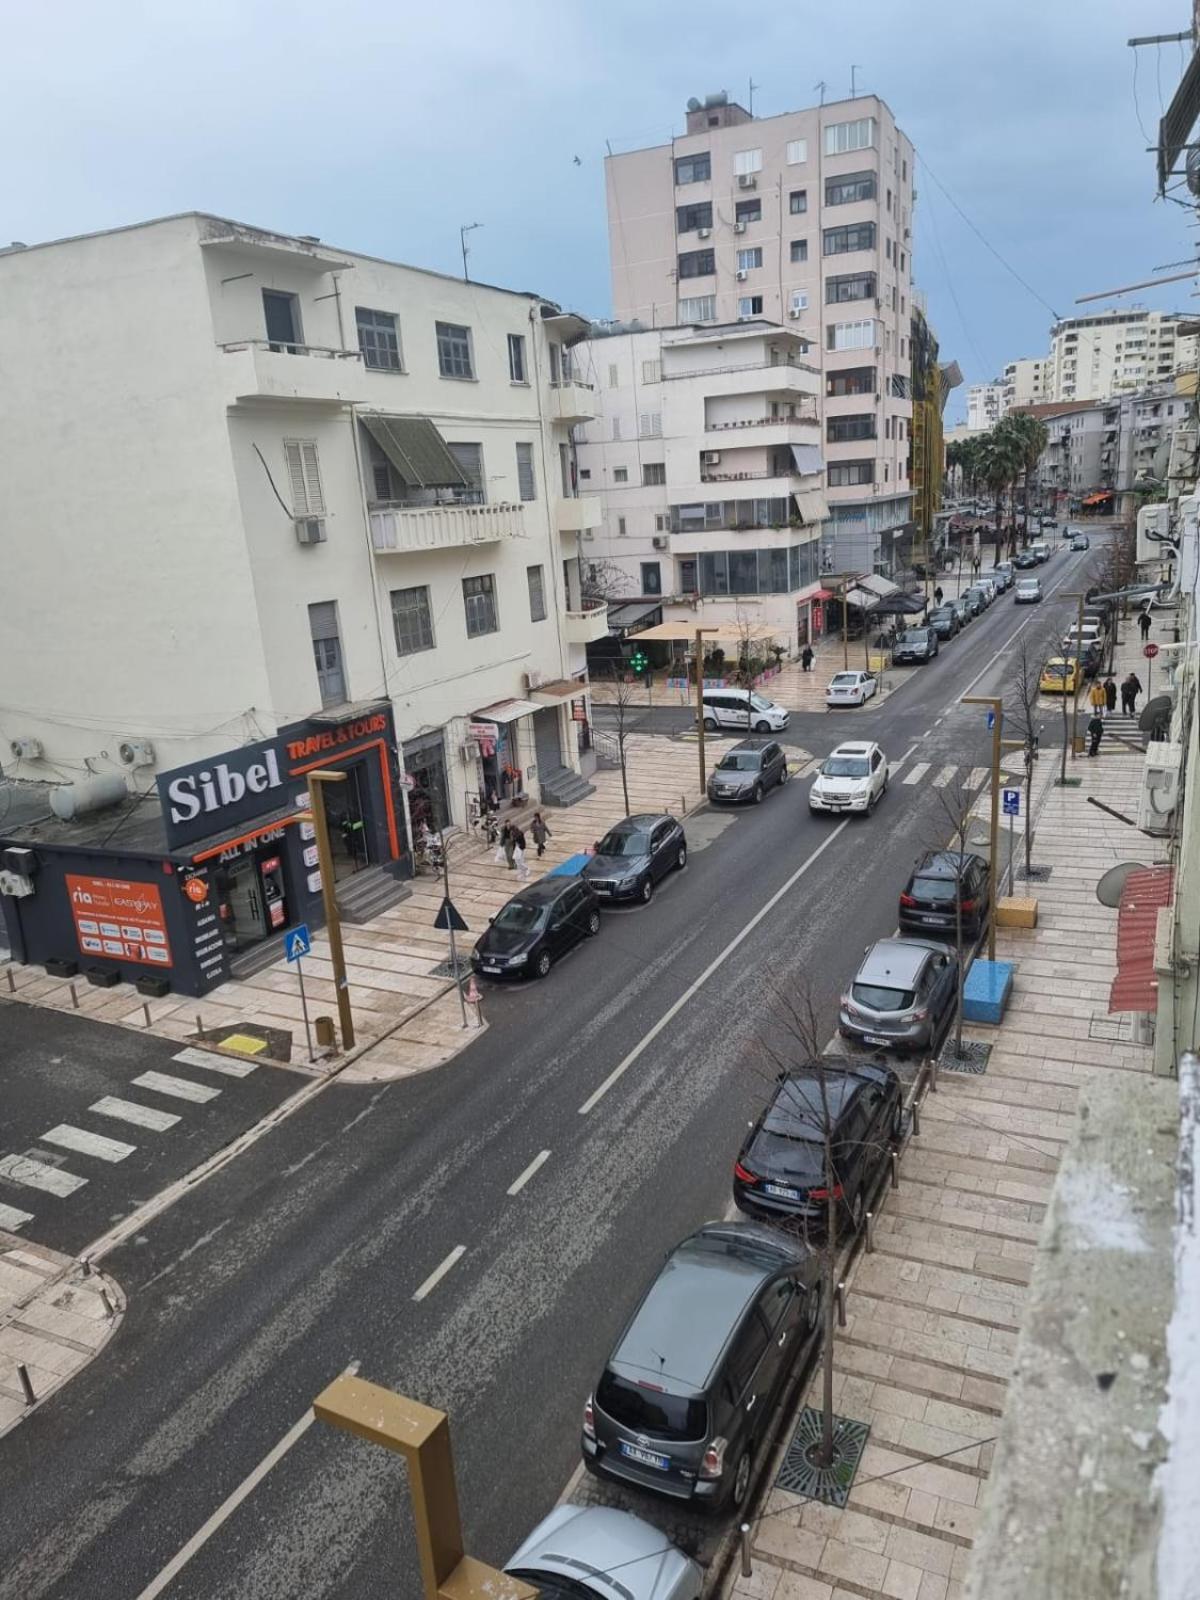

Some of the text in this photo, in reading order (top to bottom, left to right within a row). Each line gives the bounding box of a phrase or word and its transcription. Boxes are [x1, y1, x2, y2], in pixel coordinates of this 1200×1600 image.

[1144, 647, 1157, 655] STOP
[168, 748, 283, 824] Sibel
[1007, 792, 1016, 802] P
[220, 846, 241, 863] ALL
[244, 838, 258, 850] IN
[260, 828, 286, 844] ONE
[73, 886, 93, 905] ria
